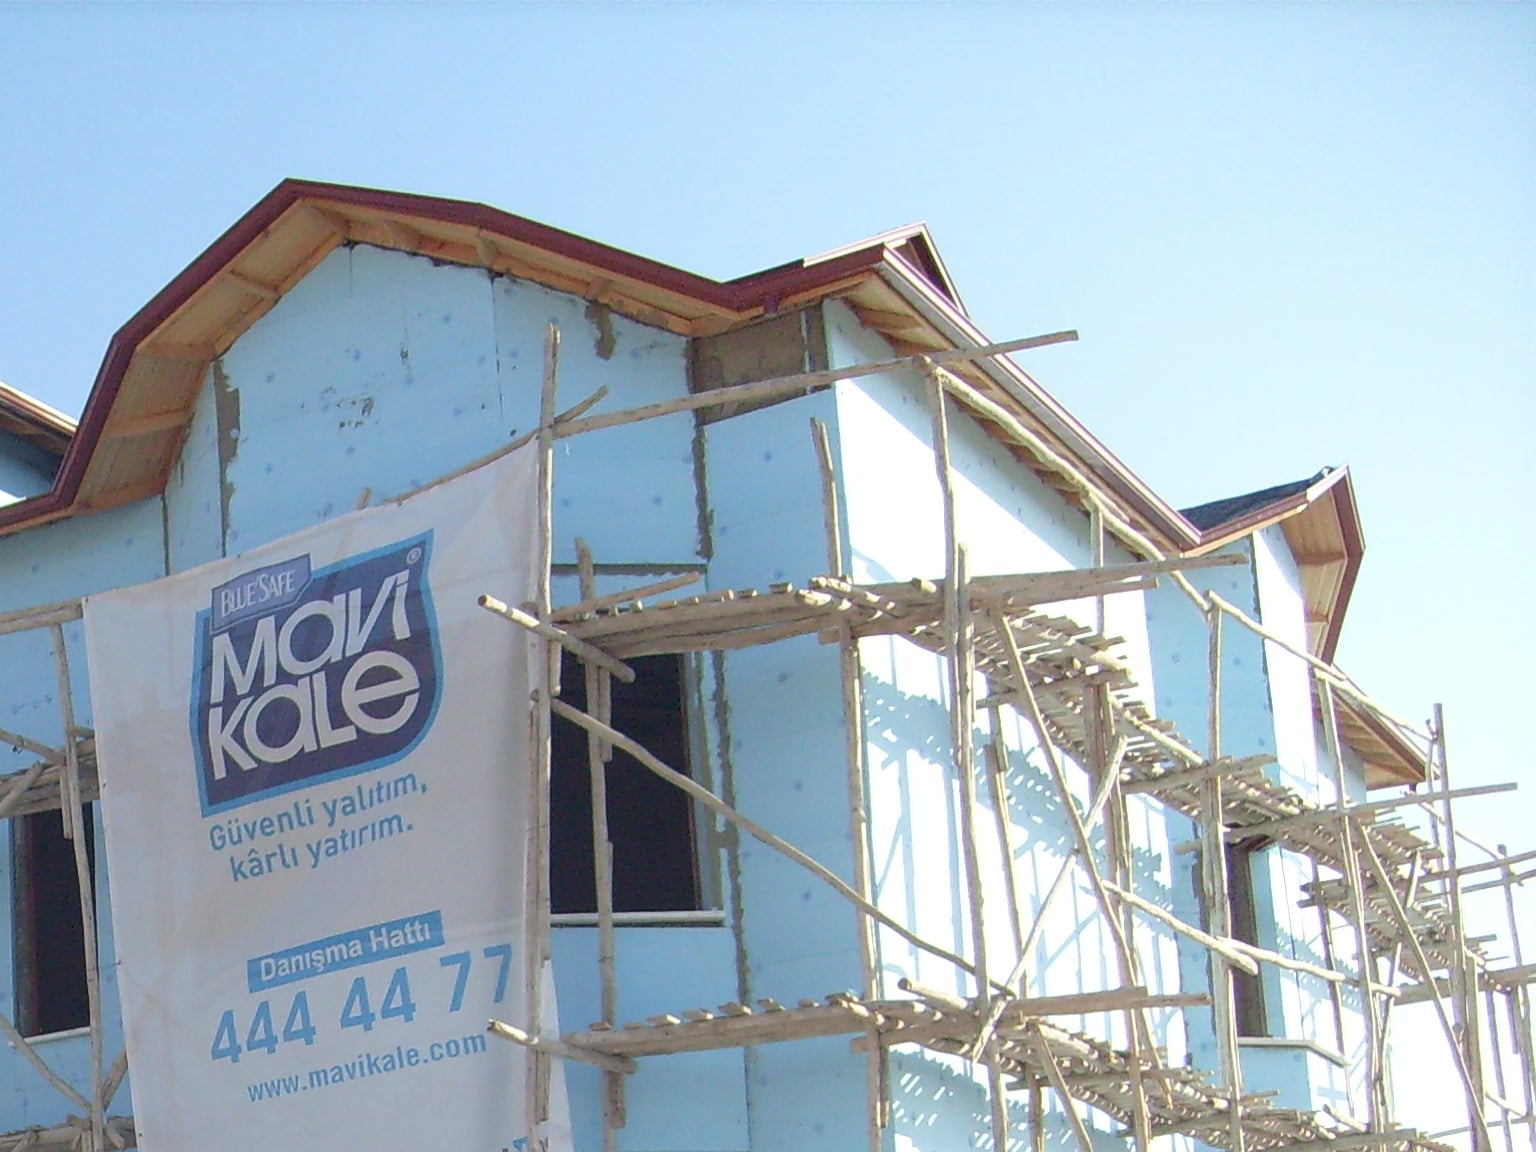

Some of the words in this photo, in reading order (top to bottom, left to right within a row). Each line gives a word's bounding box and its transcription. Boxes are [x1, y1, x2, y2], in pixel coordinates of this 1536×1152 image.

[209, 798, 315, 850] Güvenli
[260, 938, 363, 982] Danışma
[368, 920, 431, 952] Hattı
[211, 990, 316, 1064] 444
[340, 966, 416, 1032] 44
[247, 1032, 487, 1103] www.mavikale.com
